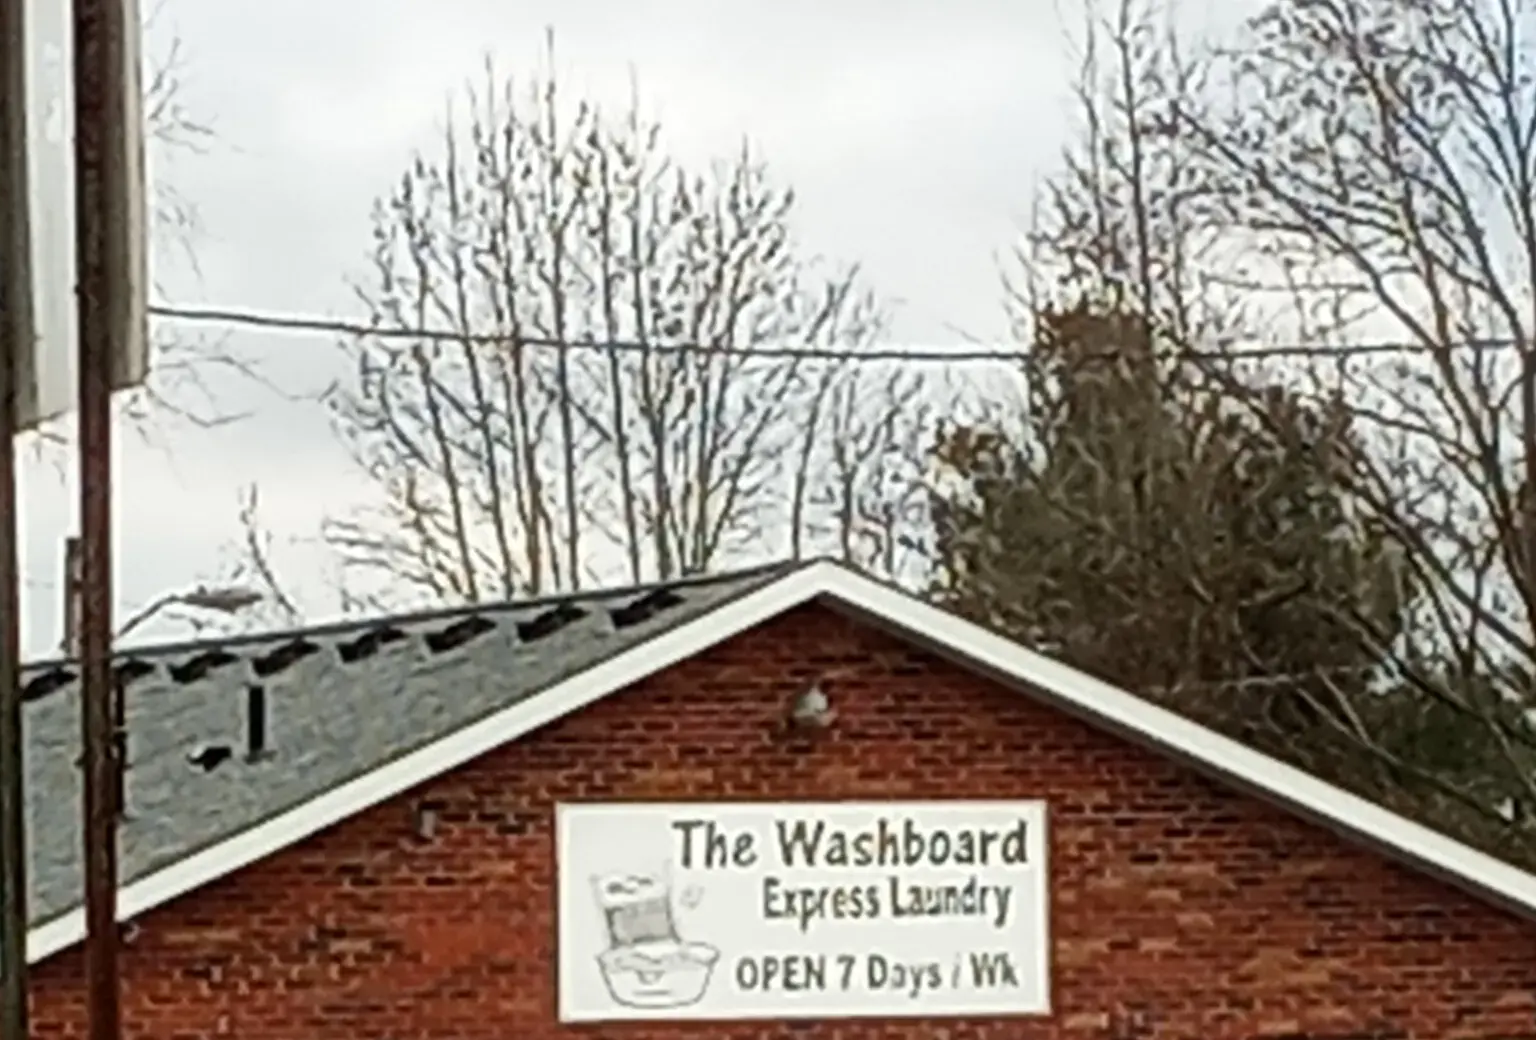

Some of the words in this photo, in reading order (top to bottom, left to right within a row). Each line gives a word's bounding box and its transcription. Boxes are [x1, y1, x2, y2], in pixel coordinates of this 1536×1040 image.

[673, 819, 757, 868] The
[775, 818, 1028, 867] Washboard
[763, 877, 881, 932] Express
[890, 876, 1013, 927] Laundry
[735, 955, 826, 990] OPEN
[836, 955, 856, 990] 7
[868, 954, 942, 998] Days
[970, 952, 1020, 988] Wk
